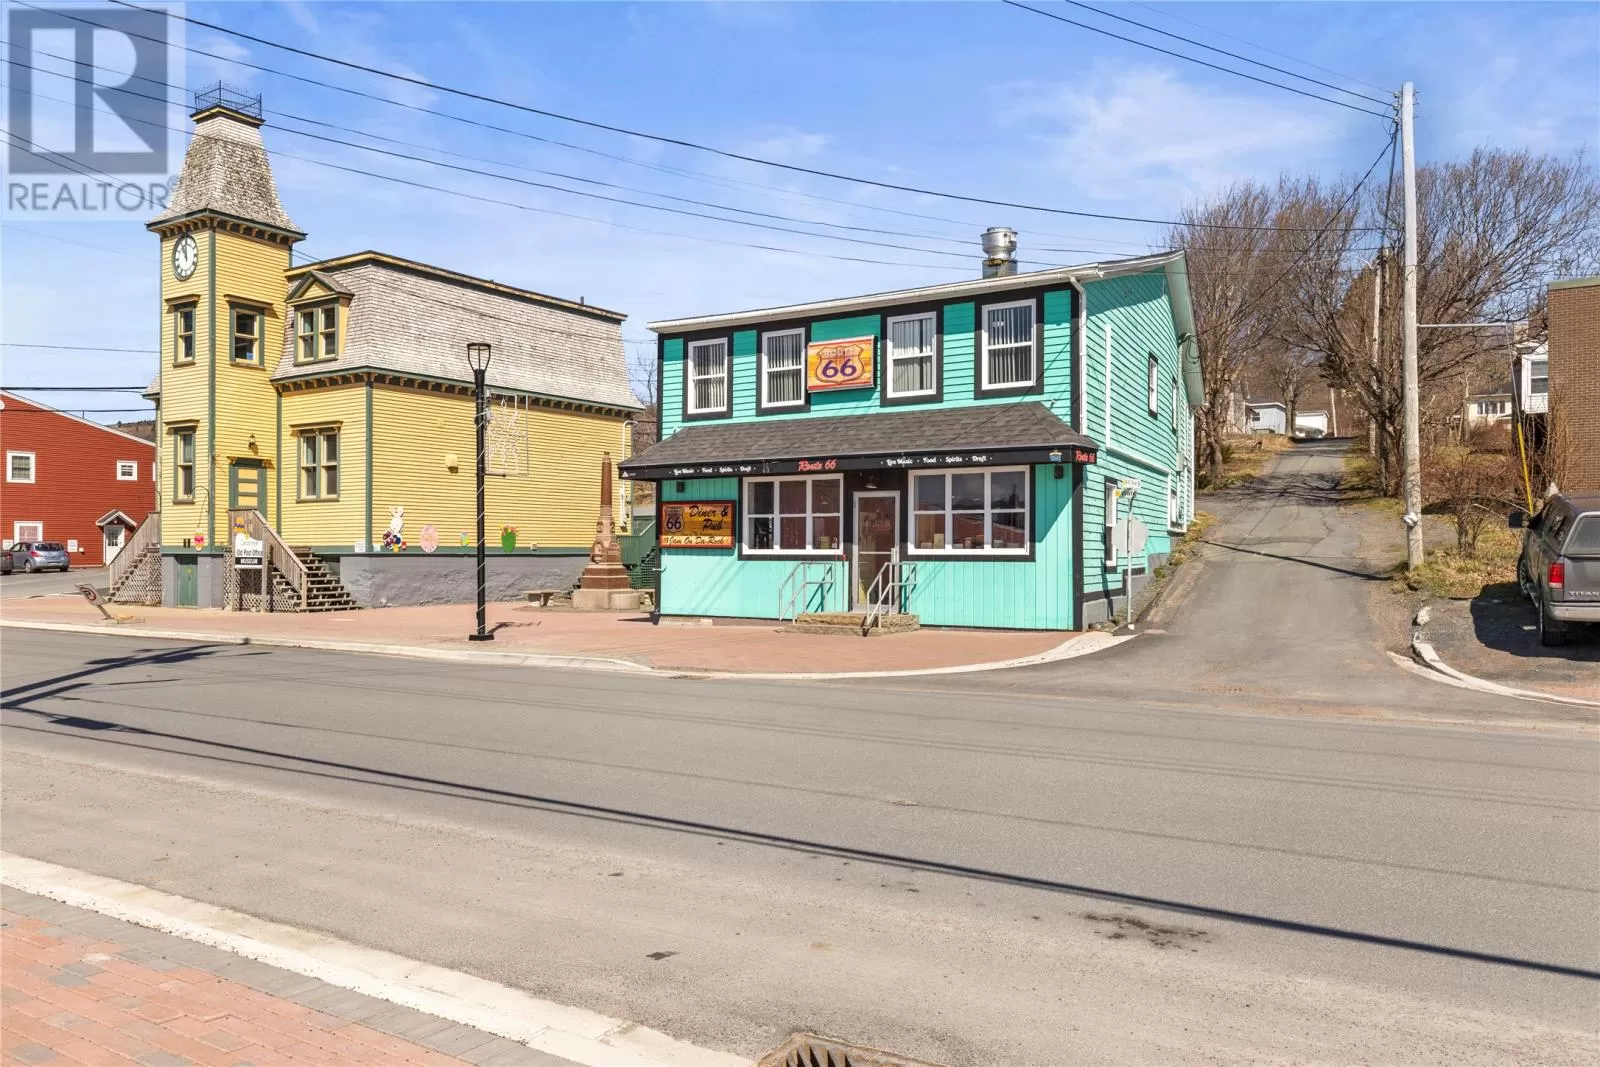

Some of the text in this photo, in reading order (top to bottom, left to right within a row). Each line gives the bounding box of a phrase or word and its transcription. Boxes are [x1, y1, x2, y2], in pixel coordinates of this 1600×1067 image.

[822, 358, 857, 378] 66
[798, 459, 837, 471] Route 66
[971, 455, 987, 463] Draft
[689, 505, 716, 517] Diner
[720, 505, 729, 517] &
[666, 516, 682, 530] 66
[703, 518, 724, 531] Pub
